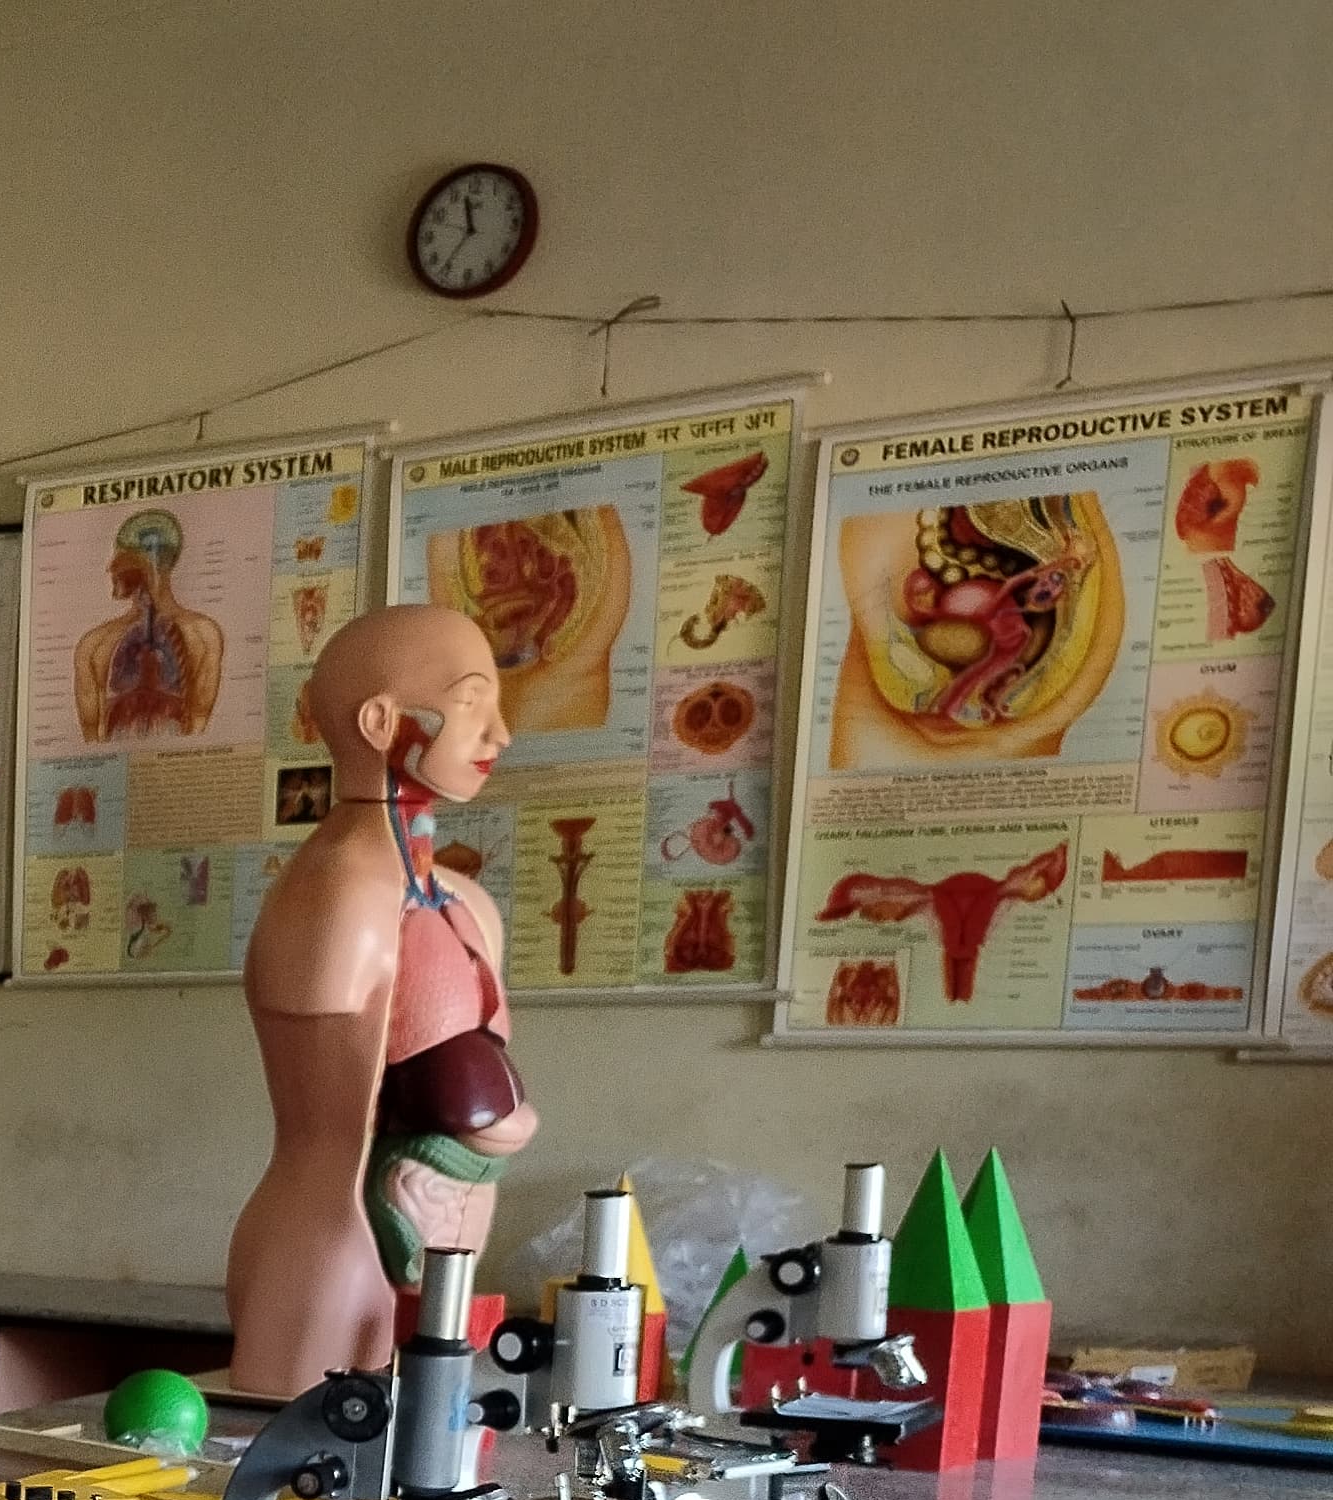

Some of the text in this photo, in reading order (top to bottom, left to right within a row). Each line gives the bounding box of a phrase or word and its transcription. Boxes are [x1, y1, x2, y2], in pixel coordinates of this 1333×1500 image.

[439, 430, 646, 479] MALE REPRODUCTIVE SYSTEM
[881, 396, 1290, 462] FEMALE REPRODUCTIVE SYSTEM
[82, 451, 334, 505] RESPIRATORY SYSTEM
[896, 477, 952, 494] FEMALE
[954, 462, 1063, 486] REPRODUCTIVE
[1065, 455, 1130, 475] ORGANS
